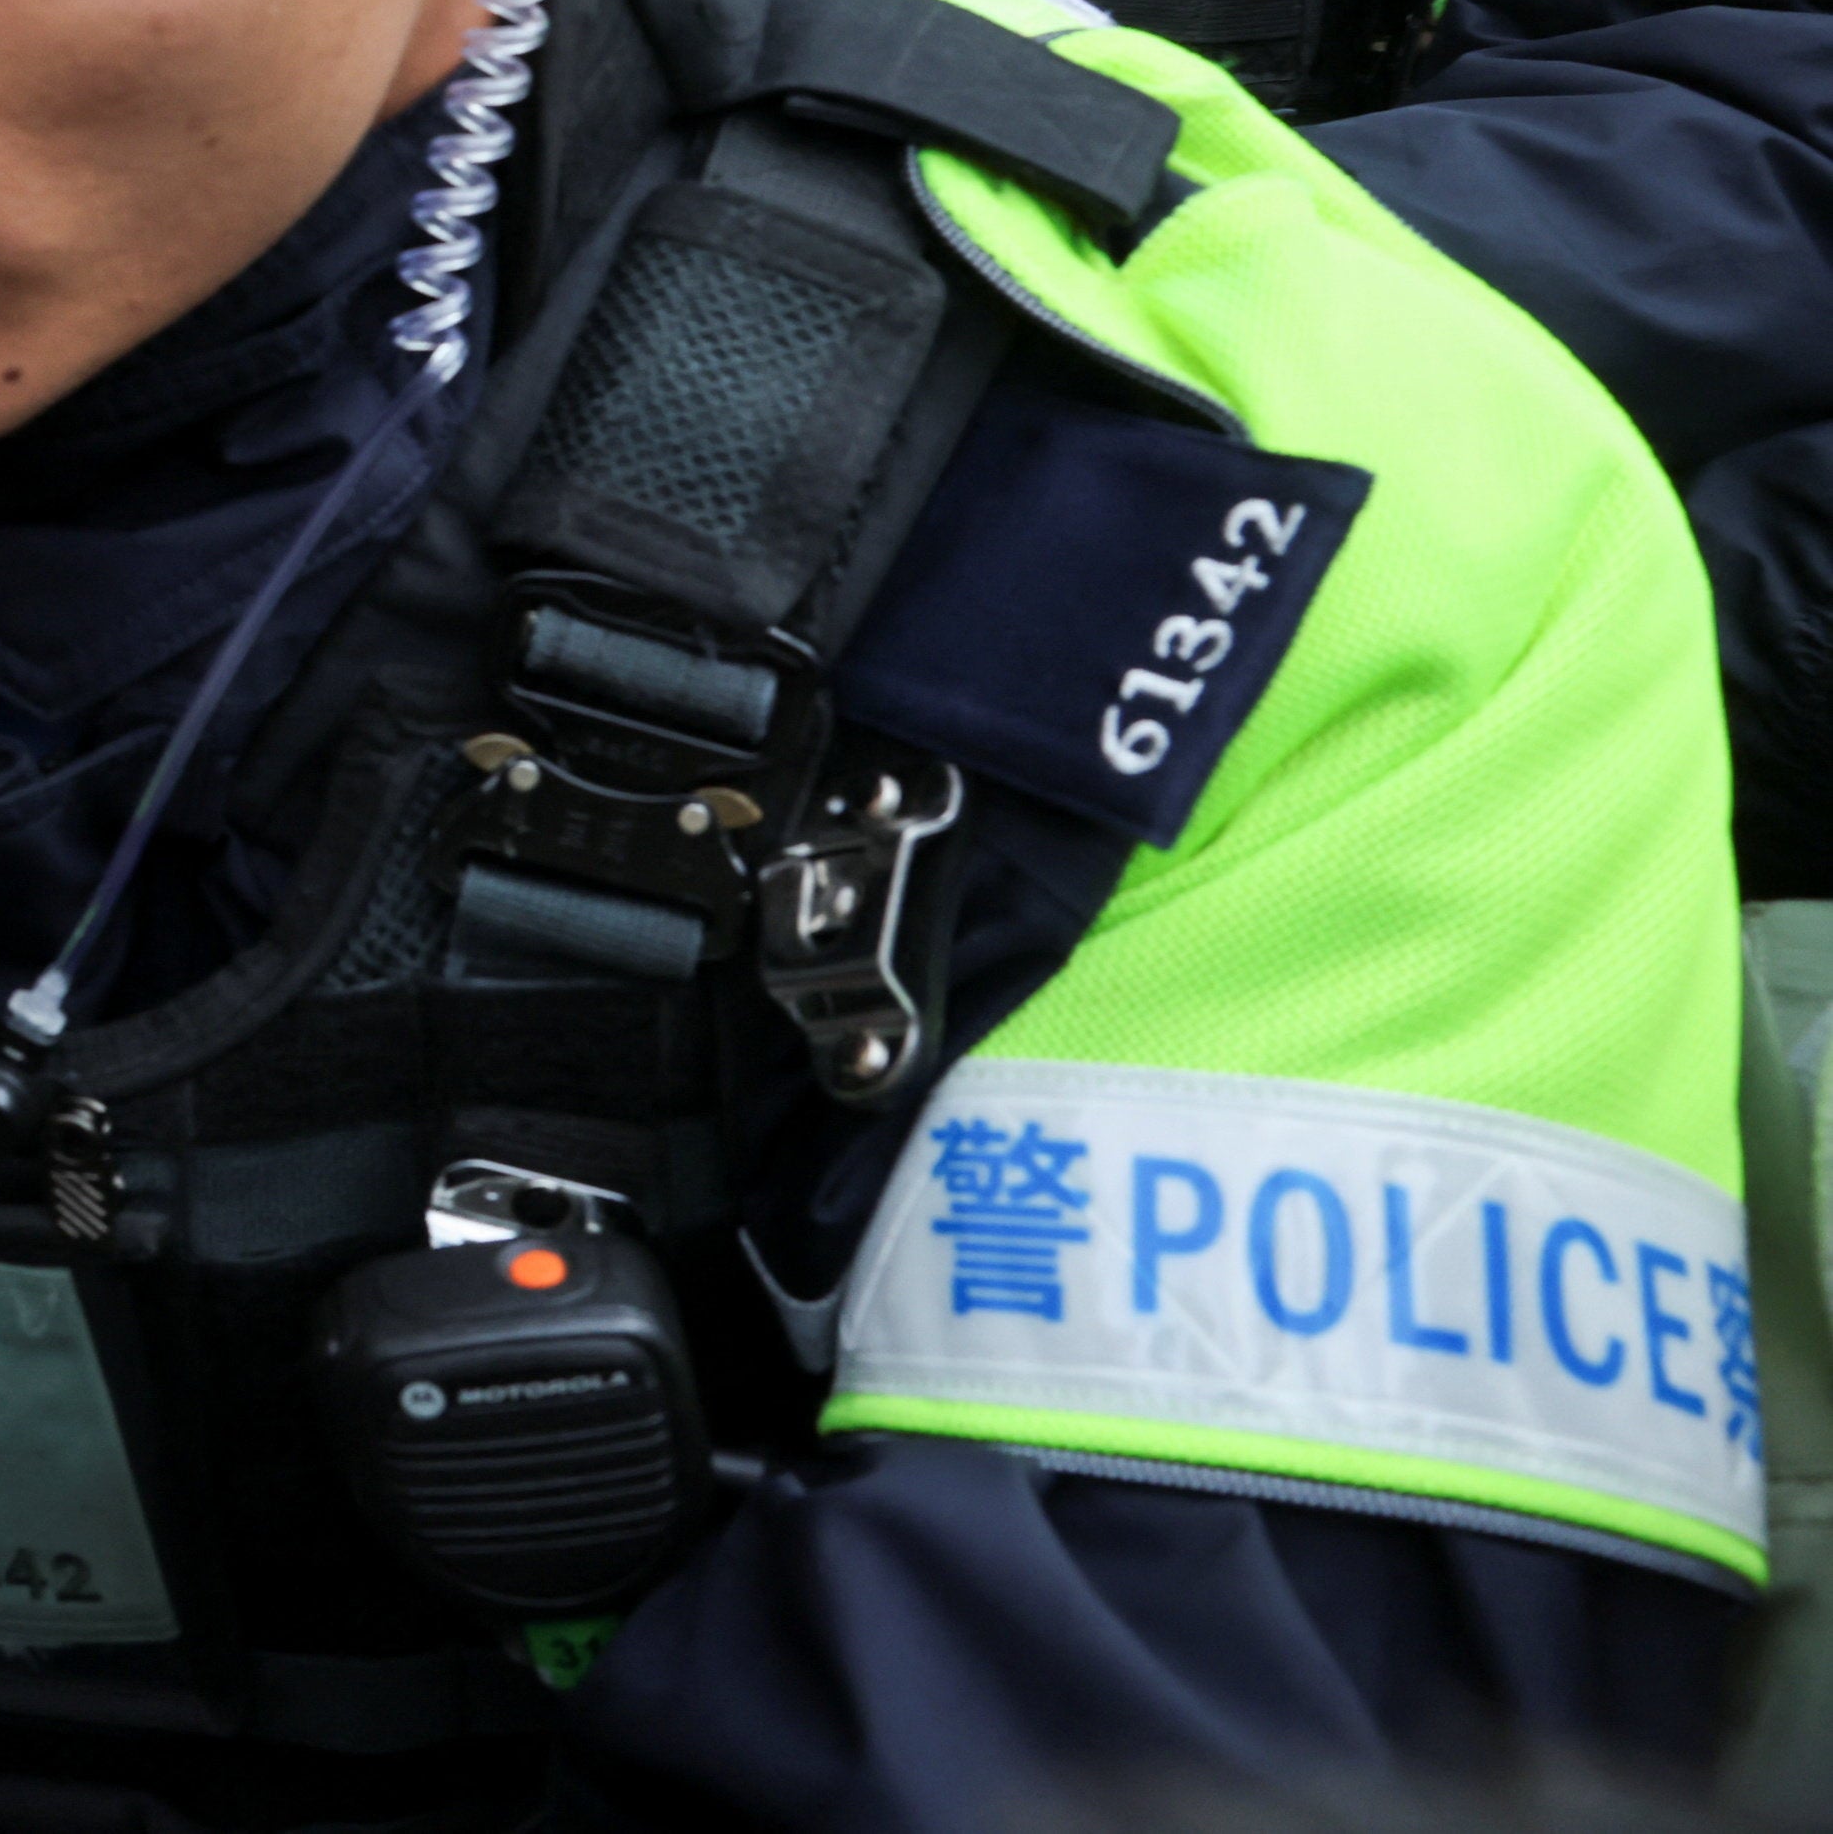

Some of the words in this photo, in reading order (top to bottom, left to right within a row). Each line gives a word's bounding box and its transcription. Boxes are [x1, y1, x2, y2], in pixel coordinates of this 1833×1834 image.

[1098, 495, 1308, 777] 61342
[457, 1370, 630, 1406] MOTOROLA
[931, 1117, 1090, 1324] 警
[1130, 1155, 1709, 1419] POLICE
